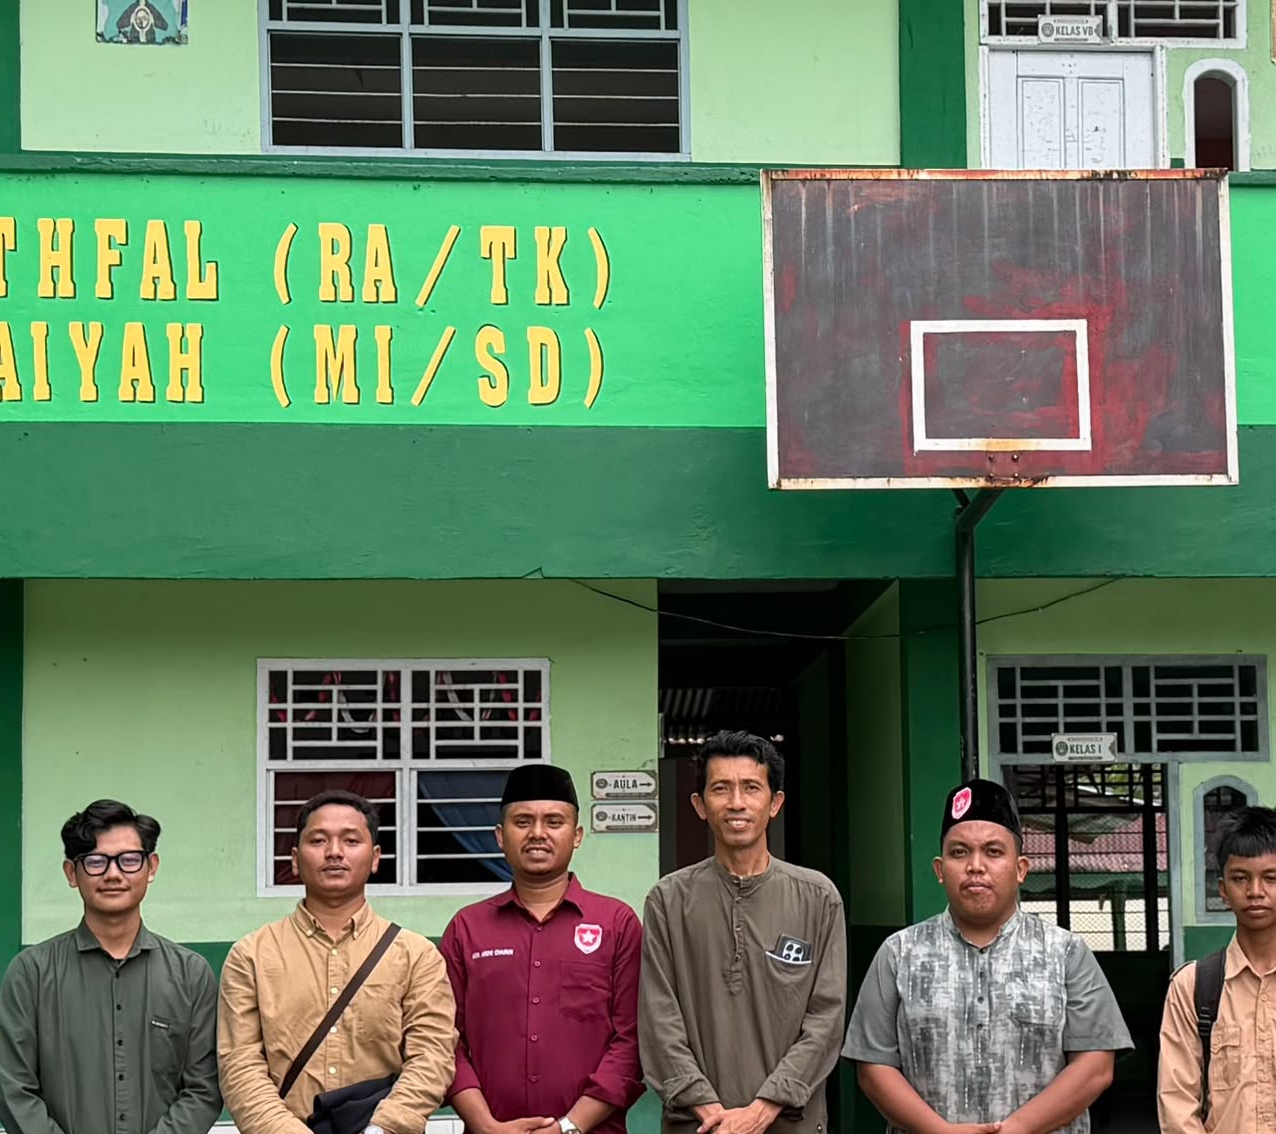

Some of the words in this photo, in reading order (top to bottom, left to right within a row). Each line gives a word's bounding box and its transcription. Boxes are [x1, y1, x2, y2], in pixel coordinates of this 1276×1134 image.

[1055, 26, 1081, 36] KELAS
[1069, 743, 1096, 754] KELAS
[1098, 743, 1102, 754] I
[613, 779, 638, 789] AULA
[611, 813, 637, 822] KANTIN
